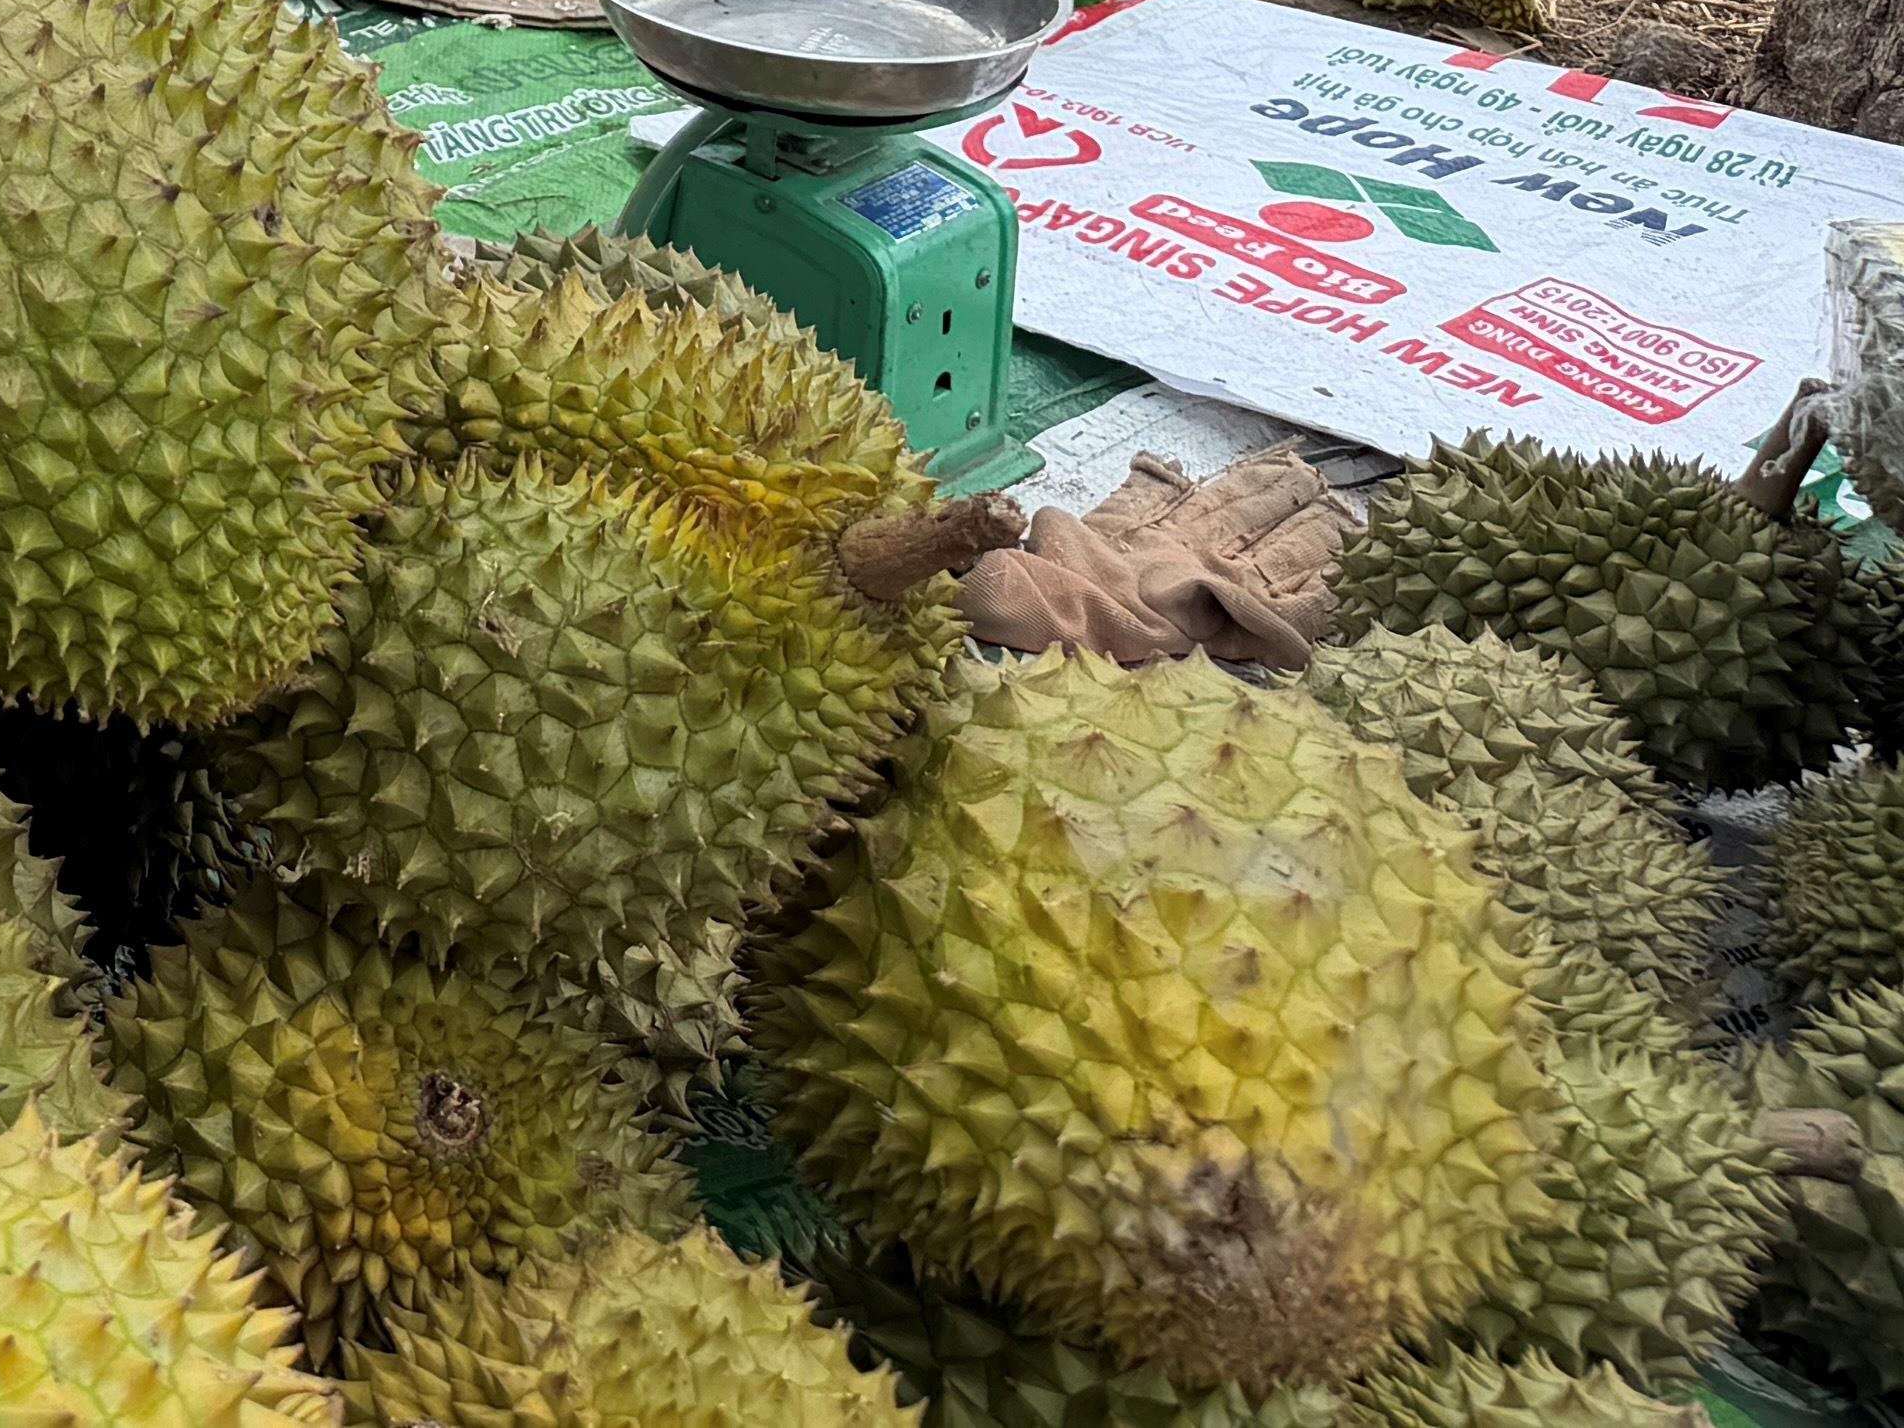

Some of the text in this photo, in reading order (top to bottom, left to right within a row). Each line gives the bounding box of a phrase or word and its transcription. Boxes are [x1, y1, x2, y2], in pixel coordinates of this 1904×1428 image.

[1325, 45, 1395, 75] tuổi
[1292, 72, 1353, 101] thịt
[1394, 63, 1479, 97] ngày
[1352, 92, 1405, 113] gà
[1477, 87, 1523, 113] 49
[1400, 105, 1465, 132] cho
[1541, 110, 1615, 142] tuổi
[1467, 127, 1535, 159] hợp
[1615, 126, 1707, 164] ngày
[1248, 97, 1710, 247] New Hope
[1706, 149, 1757, 178] 28
[1611, 170, 1660, 194] ăn
[1660, 188, 1750, 225] Thức
[1145, 198, 1394, 300] Bio Feed
[1210, 272, 1390, 344] HOPE
[1508, 304, 1693, 394] KHÁNG SINH
[1535, 286, 1741, 379] ISO 9001:2015
[1378, 337, 1545, 409] NEW
[1467, 317, 1665, 417] KHÔNG DÙNG
